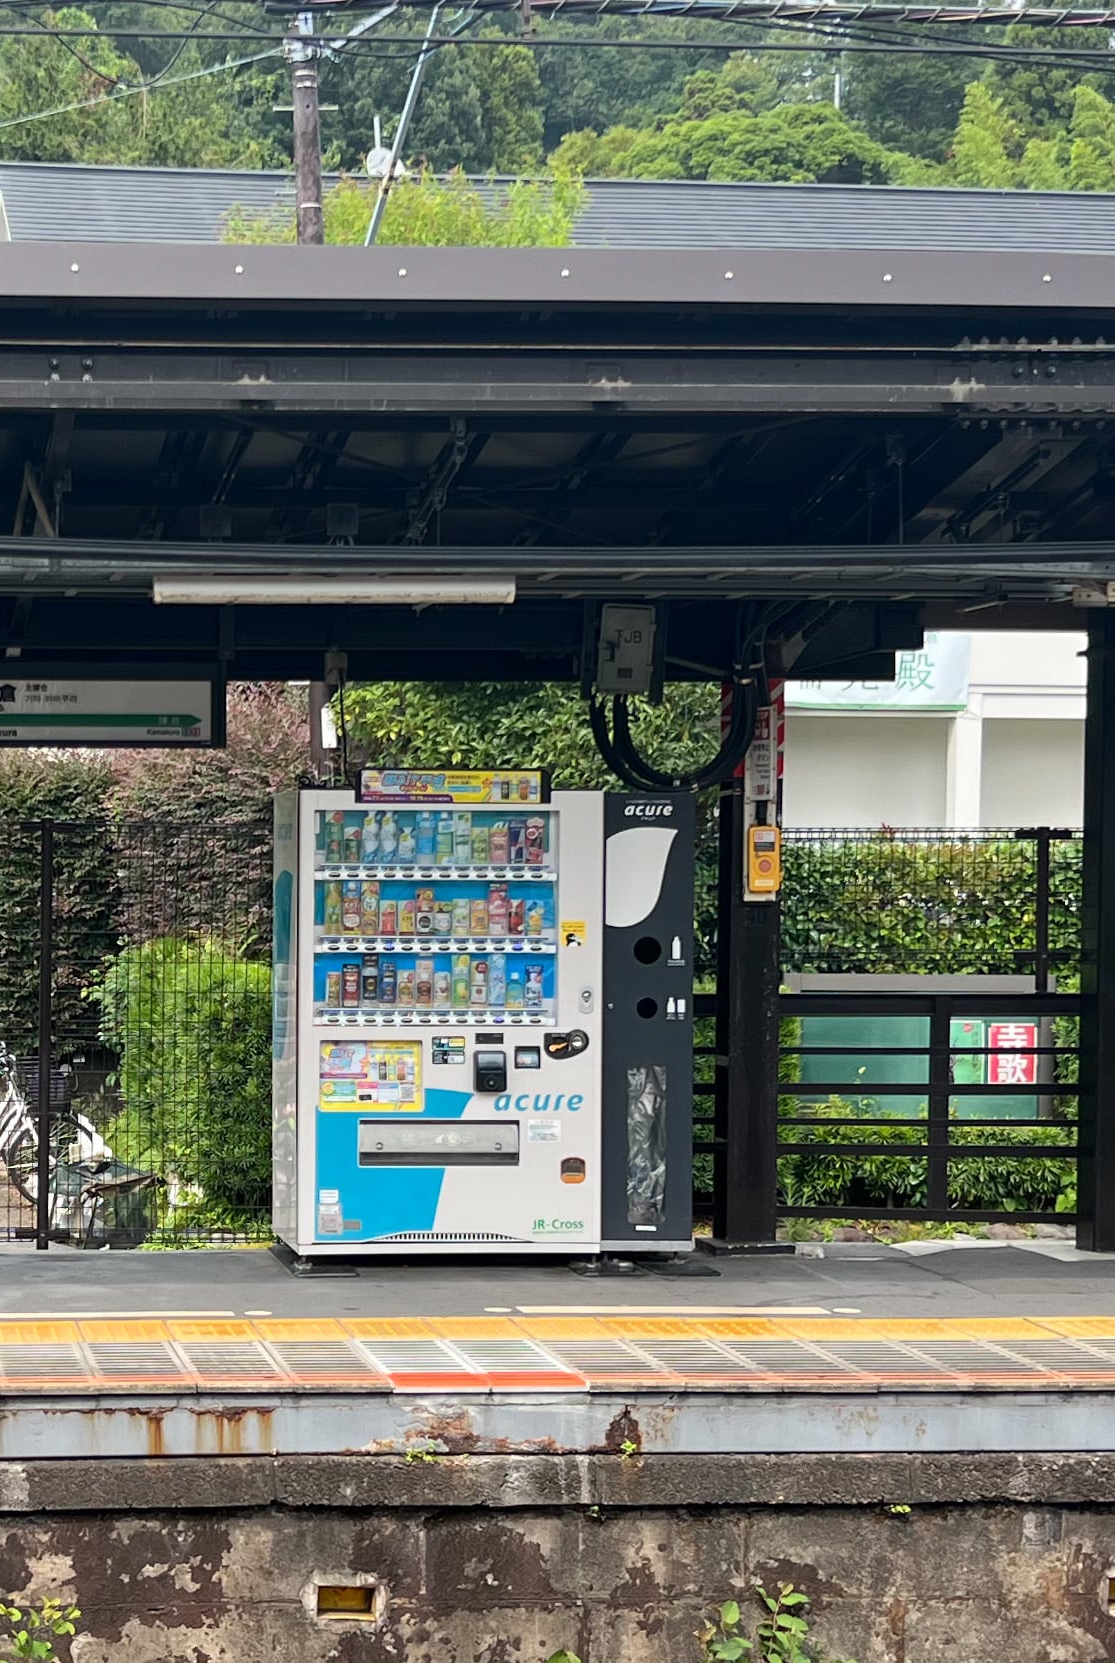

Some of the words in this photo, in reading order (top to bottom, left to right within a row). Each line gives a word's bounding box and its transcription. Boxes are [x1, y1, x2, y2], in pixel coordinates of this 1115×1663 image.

[624, 805, 673, 816] acure
[494, 1093, 584, 1112] acure
[532, 1218, 584, 1230] JR-Cross
